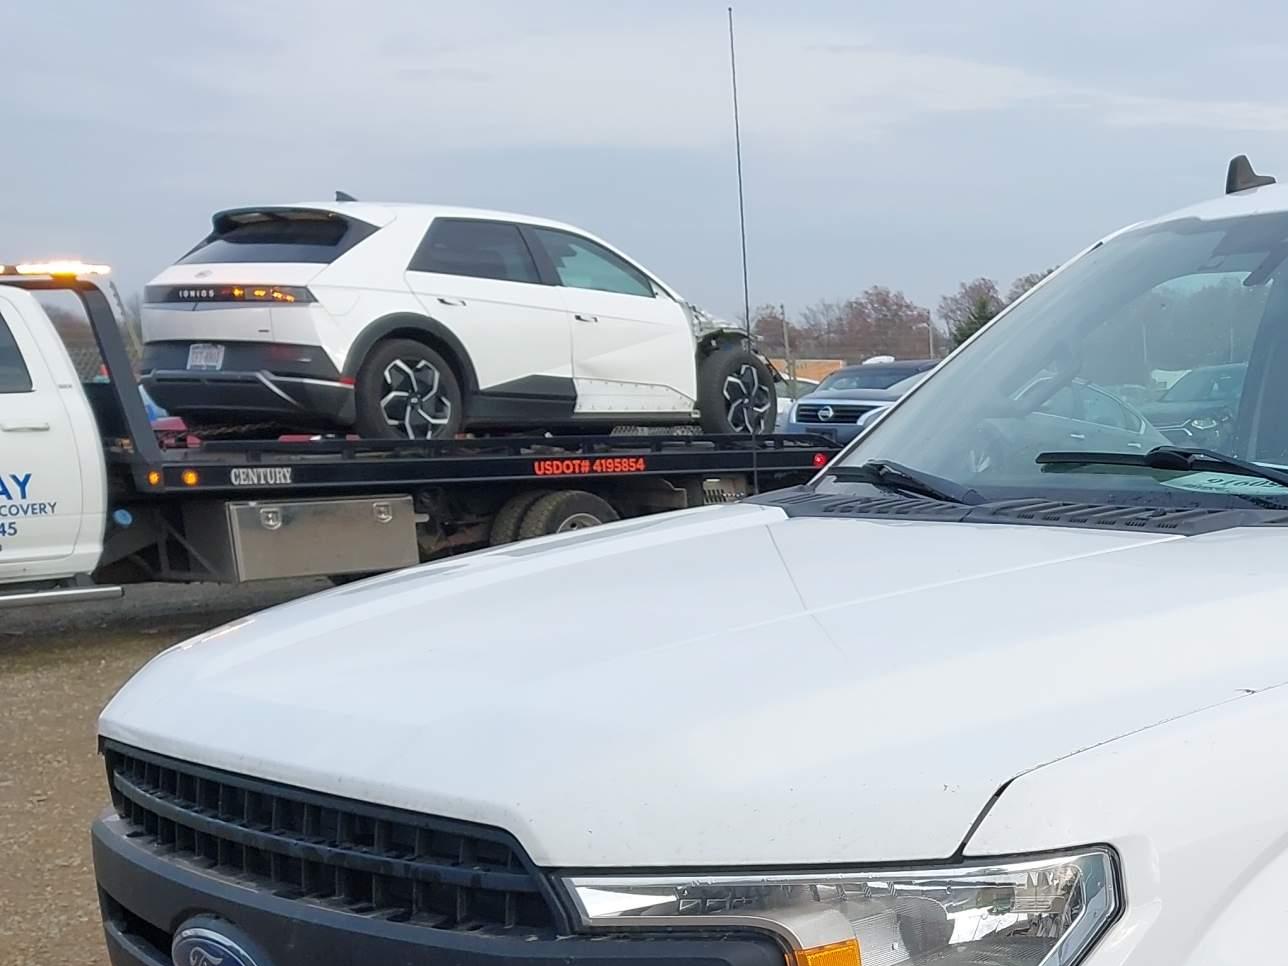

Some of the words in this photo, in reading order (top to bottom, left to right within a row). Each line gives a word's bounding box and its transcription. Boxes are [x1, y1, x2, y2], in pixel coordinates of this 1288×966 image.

[534, 459, 590, 475] USDOT#
[592, 457, 645, 472] 4195854
[231, 467, 292, 485] CENTURY
